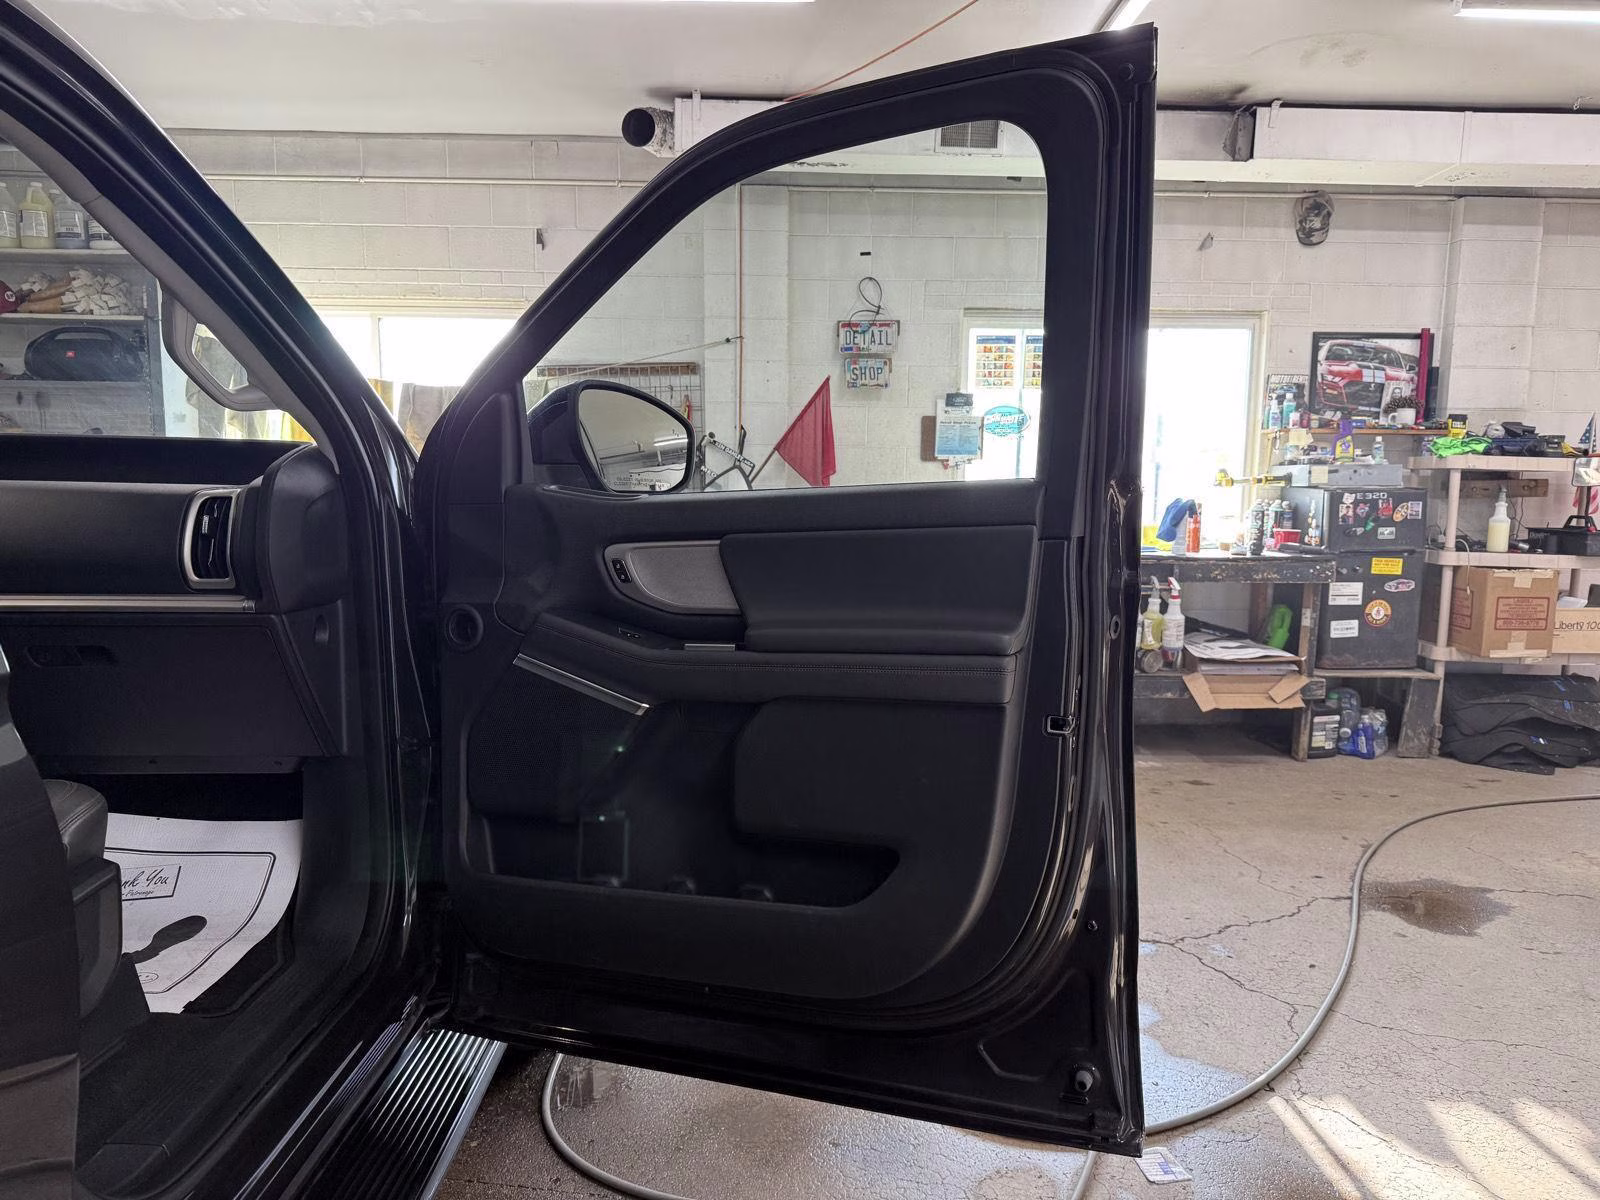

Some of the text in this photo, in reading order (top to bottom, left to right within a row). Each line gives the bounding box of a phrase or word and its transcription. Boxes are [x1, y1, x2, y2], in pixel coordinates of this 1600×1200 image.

[845, 329, 892, 345] DETAIL
[852, 366, 883, 381] SHOP
[146, 868, 169, 887] You
